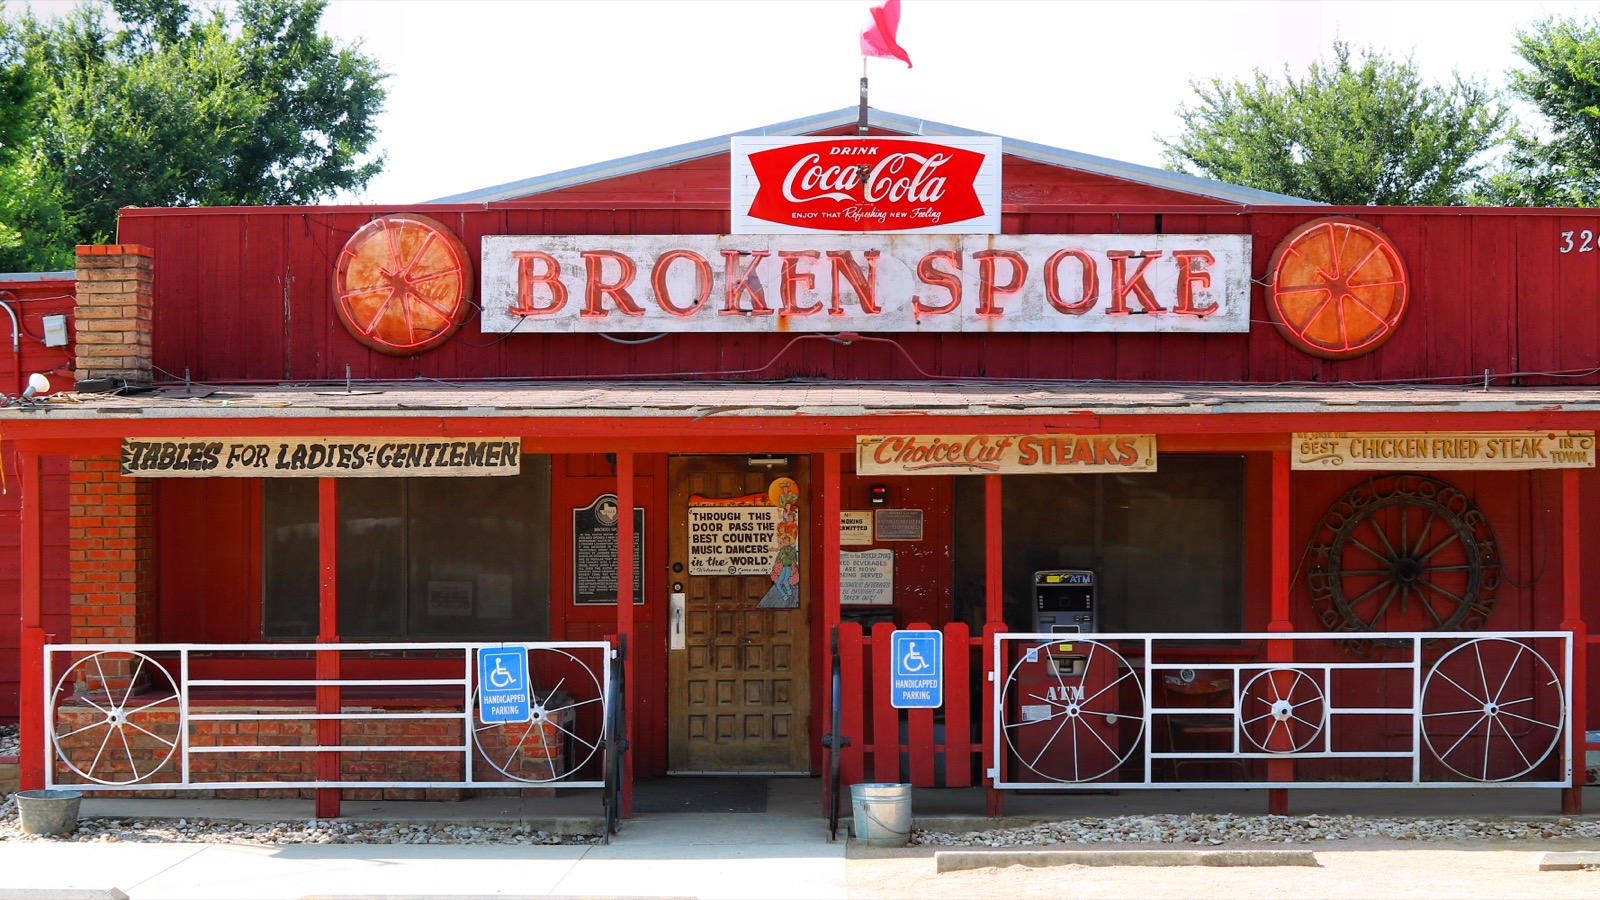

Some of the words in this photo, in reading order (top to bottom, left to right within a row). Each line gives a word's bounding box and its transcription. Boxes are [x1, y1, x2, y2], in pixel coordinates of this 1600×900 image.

[829, 146, 879, 155] DRINK
[782, 152, 954, 203] CocaCola
[842, 206, 887, 223] Refreshing
[909, 206, 942, 223] Feeling
[1560, 229, 1600, 253] 32
[508, 250, 882, 317] BROKEN
[911, 248, 1220, 318] SPOKE
[1300, 441, 1340, 455] BEST
[1350, 438, 1428, 459] CHICKEN
[1432, 438, 1480, 459] FRIED
[1485, 438, 1548, 459] STEAK
[1559, 437, 1574, 449] IN
[128, 442, 224, 471] TABLES
[225, 443, 271, 469] FOR
[275, 442, 371, 470] LADIES
[376, 441, 520, 469] GENTLEMEN
[874, 436, 961, 465] Choice
[963, 434, 1013, 465] Cut
[1018, 436, 1140, 467] STEAKS
[1550, 450, 1588, 464] TOWN
[692, 512, 741, 521] THROUGH
[748, 512, 771, 521] THIS
[692, 523, 723, 532] DOOR
[729, 522, 754, 532] PASS
[757, 522, 775, 531] THE
[693, 534, 718, 543] BEST
[722, 533, 775, 543] COUNTRY
[692, 545, 722, 554] MUSIC
[725, 545, 769, 554] DANCERS
[691, 556, 704, 567] in
[706, 556, 728, 566] the
[1070, 574, 1091, 583] ATM
[896, 680, 938, 689] HANDICAPPED
[903, 691, 931, 700] PARKING
[1046, 685, 1085, 701] ATM
[484, 694, 526, 705] HANDICAPPED
[491, 706, 519, 715] PARKING
